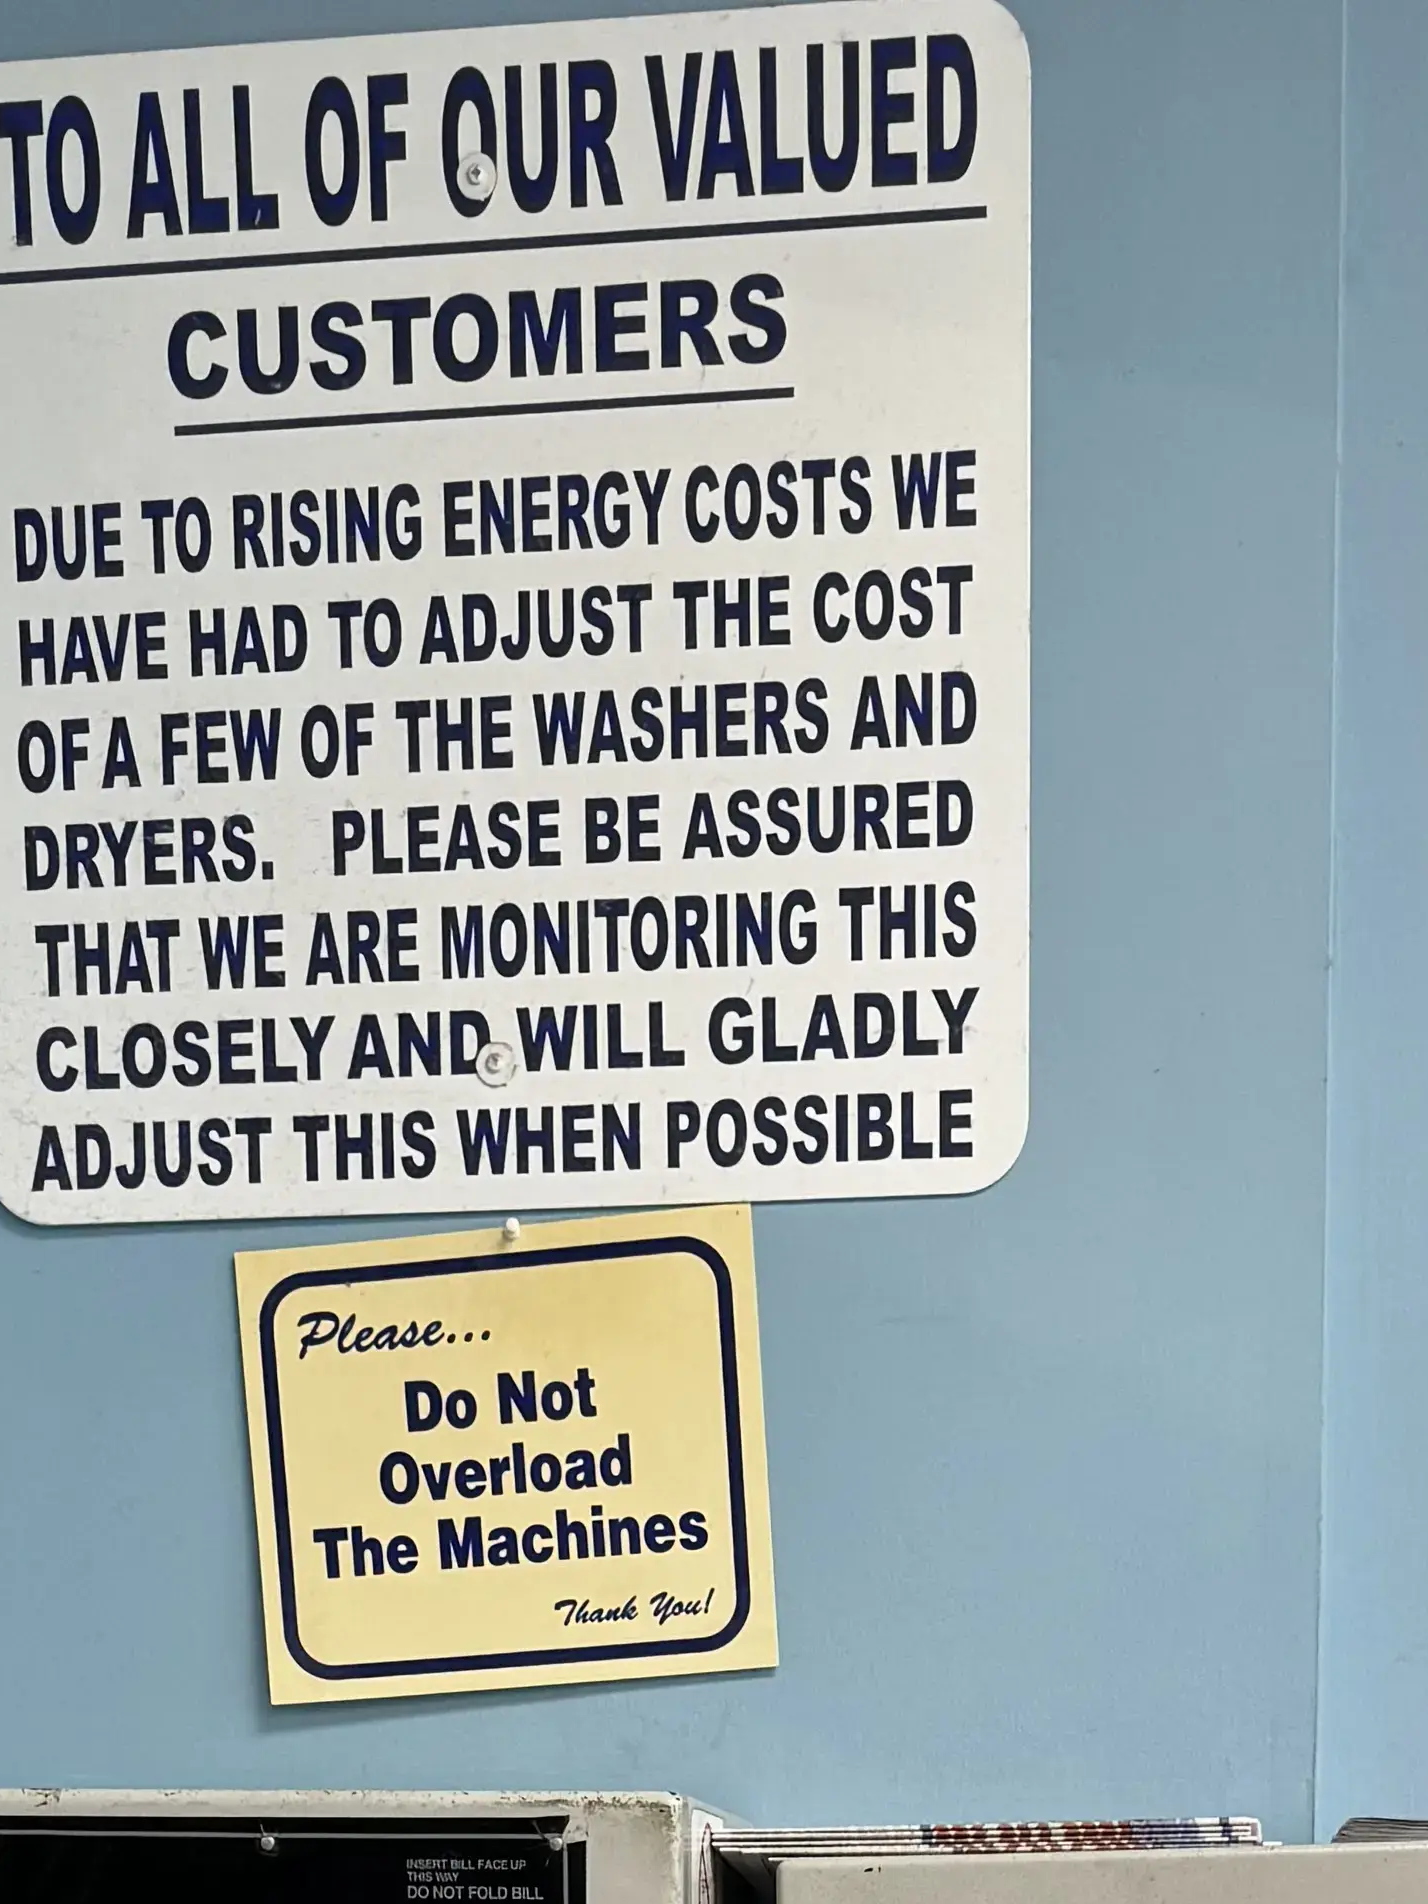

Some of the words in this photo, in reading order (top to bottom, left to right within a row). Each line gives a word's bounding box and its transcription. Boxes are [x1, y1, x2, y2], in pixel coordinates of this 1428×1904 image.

[127, 85, 279, 238] ALL
[305, 73, 408, 226] OF
[442, 60, 623, 217] OUR
[645, 34, 977, 201] VALUED
[168, 274, 786, 399] CUSTOMERS
[14, 503, 123, 582] DUE
[141, 497, 211, 573] TO
[233, 484, 421, 569] RISING
[444, 469, 671, 556] ENERGY
[686, 456, 871, 543] COSTS
[892, 450, 976, 529] WE
[19, 612, 168, 686] HAVE
[189, 605, 307, 676] HAD
[328, 598, 401, 668] TO
[420, 584, 652, 664] ADJUST
[673, 576, 790, 649] THE
[814, 565, 972, 642] COST
[18, 718, 89, 793] OF
[102, 717, 141, 788] A
[161, 708, 281, 785] FEW
[301, 703, 374, 778] OF
[396, 696, 513, 772] THE
[533, 678, 828, 765] WASHERS
[851, 671, 976, 750] AND
[25, 815, 273, 891] DRYERS.
[333, 800, 561, 876] PLEASE
[585, 795, 660, 863] BE
[683, 780, 973, 859] ASSURED
[35, 919, 180, 997] THAT
[199, 914, 285, 989] WE
[306, 908, 419, 985] ARE
[442, 890, 816, 979] MONITORING
[839, 881, 976, 961] THIS
[37, 1016, 335, 1091] CLOSELY
[348, 1010, 491, 1079] AND
[516, 1002, 684, 1071] WILL
[709, 988, 979, 1064] GLADLY
[32, 1118, 271, 1190] ADJUST
[293, 1111, 436, 1181] THIS
[457, 1103, 640, 1175] WHEN
[667, 1089, 972, 1168] POSSIBLE
[298, 1312, 490, 1359] Please...
[405, 1381, 477, 1432] Do
[498, 1368, 597, 1424] Not
[380, 1434, 631, 1504] Overload
[313, 1526, 418, 1578] The
[438, 1505, 708, 1569] Machines
[555, 1596, 638, 1626] Thank
[650, 1588, 714, 1625] You!
[406, 1859, 448, 1870] INSERT
[450, 1859, 475, 1870] BILL
[478, 1859, 508, 1870] FACE
[510, 1859, 527, 1870] UP
[407, 1871, 433, 1882] THIS
[435, 1872, 459, 1882] WAY
[407, 1885, 429, 1899] DO
[432, 1885, 464, 1899] NOT
[468, 1886, 508, 1899] FOLD
[511, 1886, 544, 1900] BILL
